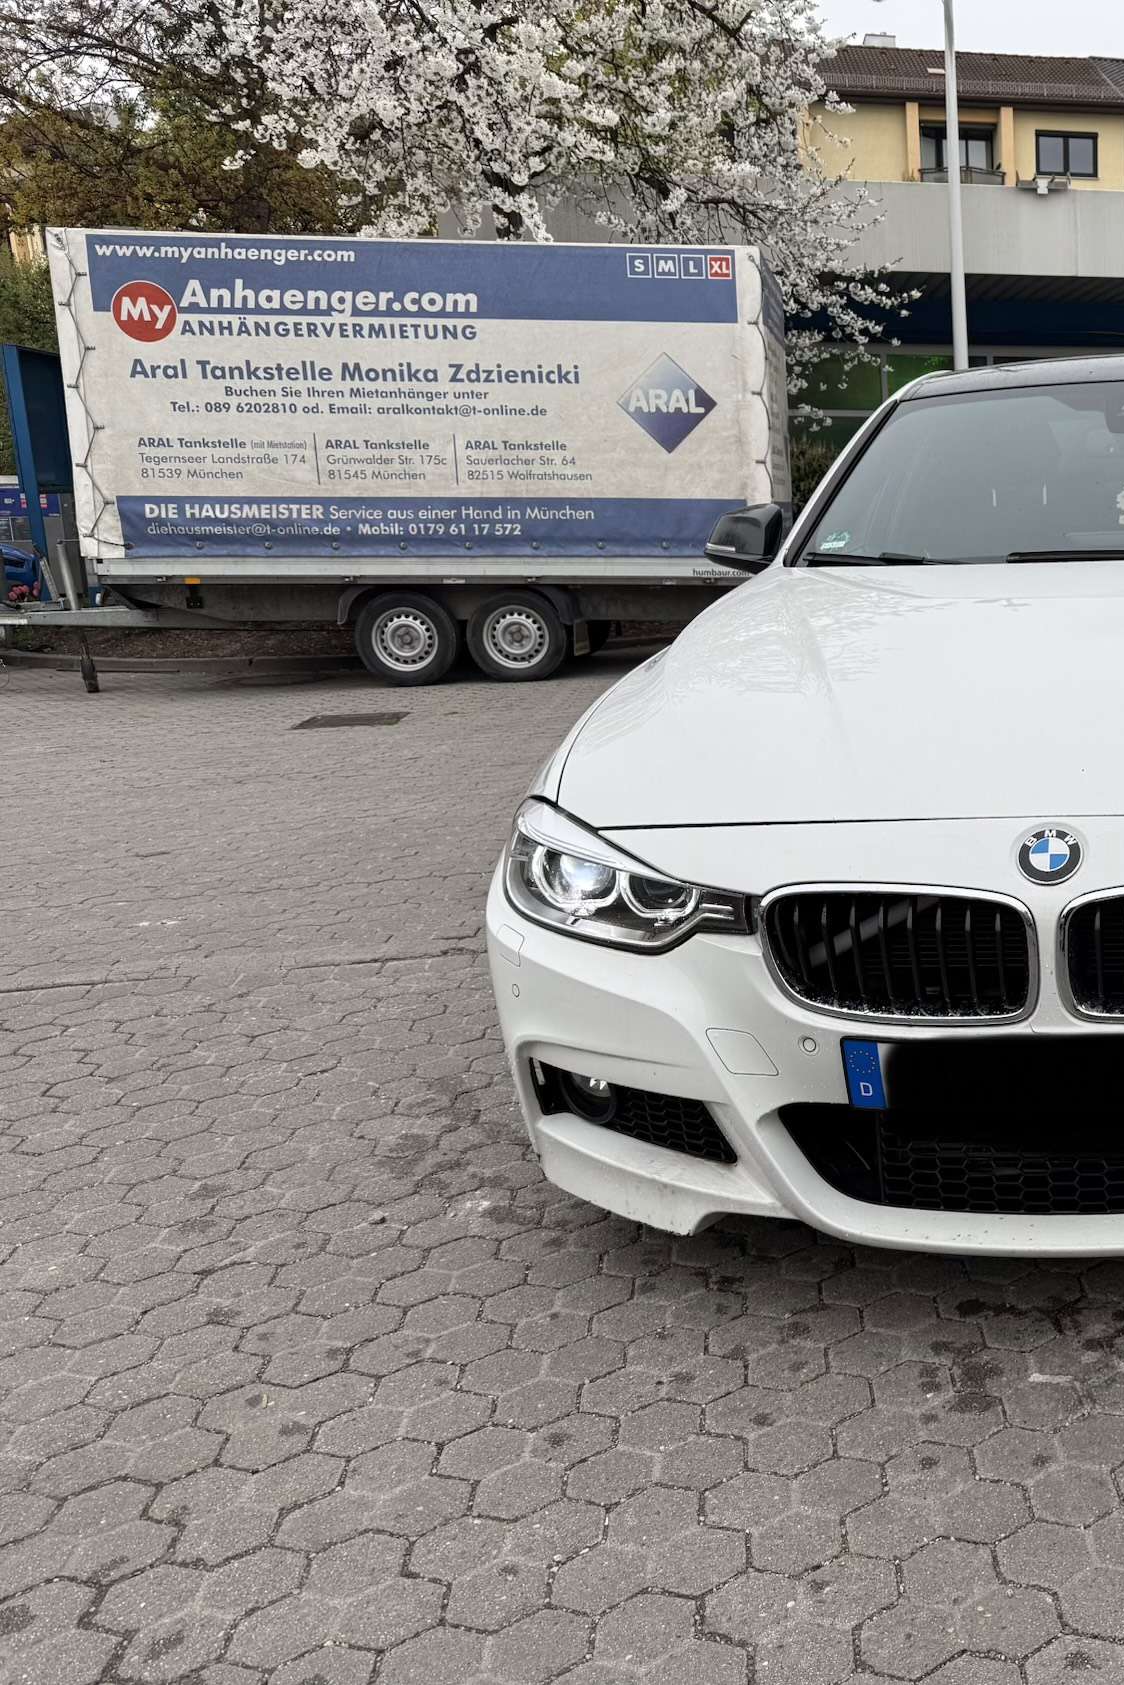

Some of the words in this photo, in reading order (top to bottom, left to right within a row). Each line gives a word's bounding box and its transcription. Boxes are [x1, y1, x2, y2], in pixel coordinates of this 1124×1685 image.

[94, 242, 355, 265] www.myanhaenger.com
[633, 258, 645, 272] S
[657, 259, 675, 273] M
[688, 260, 698, 273] L
[710, 260, 730, 274] XL
[119, 296, 172, 329] My
[179, 278, 478, 317] Anhaenger.com
[180, 316, 478, 341] ANHÄNGERVERMIETUNG
[129, 358, 188, 380] Aral
[196, 359, 333, 382] Tankstelle
[341, 361, 439, 383] Monika
[448, 363, 580, 385] Zdzienicki
[224, 385, 277, 398] Buchen
[281, 386, 302, 398] Sie
[307, 387, 345, 398] Ihren
[350, 387, 449, 402] Mietanhänger
[453, 390, 490, 400] unter
[628, 388, 705, 414] ARAL
[170, 401, 200, 413] Tel.:
[204, 402, 231, 413] 089
[236, 402, 297, 414] 6202810
[302, 402, 324, 414] od.
[329, 403, 372, 415] Email:
[377, 404, 548, 417] aralkontakt@t-online.de
[137, 437, 174, 448] ARAL
[177, 437, 247, 449] Tankstelle
[325, 439, 359, 450] ARAL
[363, 440, 430, 450] Tankstelle
[465, 441, 498, 451] ARAL
[502, 441, 567, 451] Tankstelle
[138, 453, 208, 466] Tegernseer
[211, 453, 279, 465] Landstraße
[283, 454, 306, 465] 174
[326, 455, 396, 466] Grünwalder
[398, 455, 415, 466] Str.
[419, 455, 447, 466] 175c
[466, 455, 536, 467] Sauerlacher
[539, 456, 557, 467] Str.
[561, 456, 576, 466] 64
[141, 468, 182, 479] 81539
[187, 468, 244, 480] München
[328, 469, 367, 480] 81545
[371, 469, 426, 481] München
[467, 470, 504, 481] 82515
[506, 469, 593, 482] Wolfratshausen
[144, 503, 178, 519] DIE
[185, 503, 325, 520] HAUSMEISTER
[329, 505, 382, 520] Service
[387, 508, 414, 520] aus
[418, 506, 457, 520] einer
[461, 505, 503, 520] Hand
[507, 505, 521, 520] in
[525, 506, 594, 520] München
[147, 522, 341, 537] diehausmeister@t-online.de
[358, 523, 404, 536] Mobil:
[408, 523, 444, 536] 0179
[449, 524, 466, 535] 61
[473, 524, 490, 535] 17
[495, 523, 522, 535] 572
[692, 568, 750, 577] humbaur.com
[1025, 829, 1077, 847] BMW
[860, 1082, 873, 1096] D
